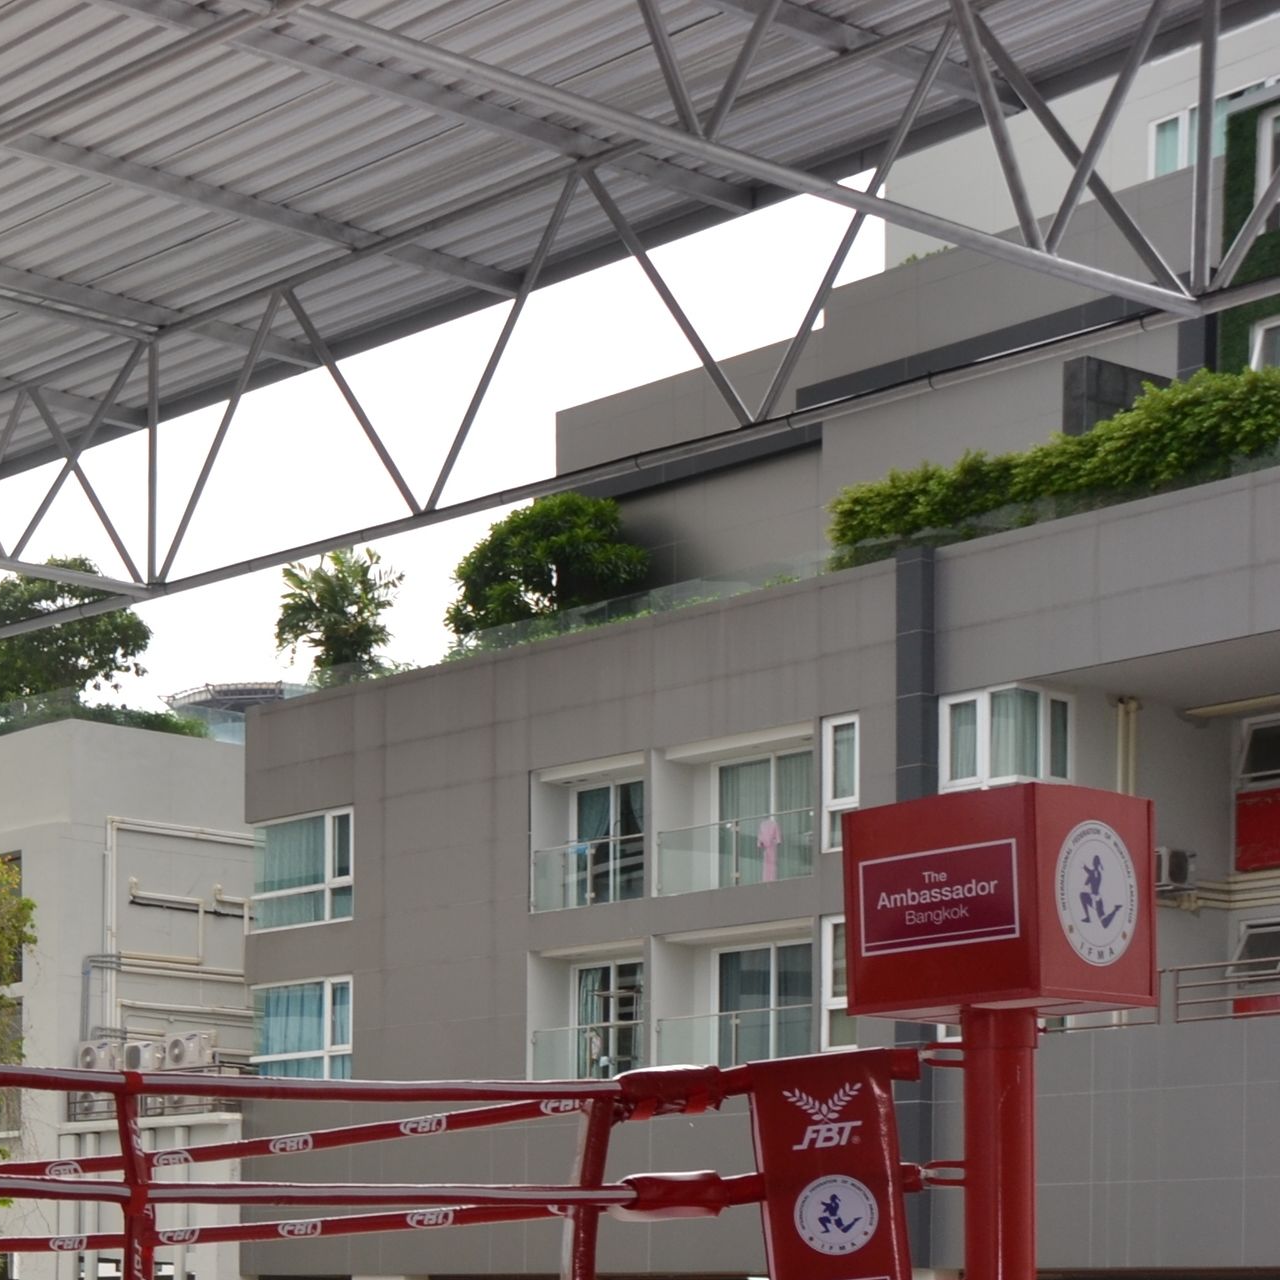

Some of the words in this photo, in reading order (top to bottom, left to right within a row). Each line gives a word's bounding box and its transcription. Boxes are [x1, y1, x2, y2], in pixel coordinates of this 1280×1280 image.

[922, 871, 948, 884] The
[877, 876, 998, 910] Ambassador
[905, 905, 969, 926] Bangkok
[792, 1120, 863, 1151] FBT
